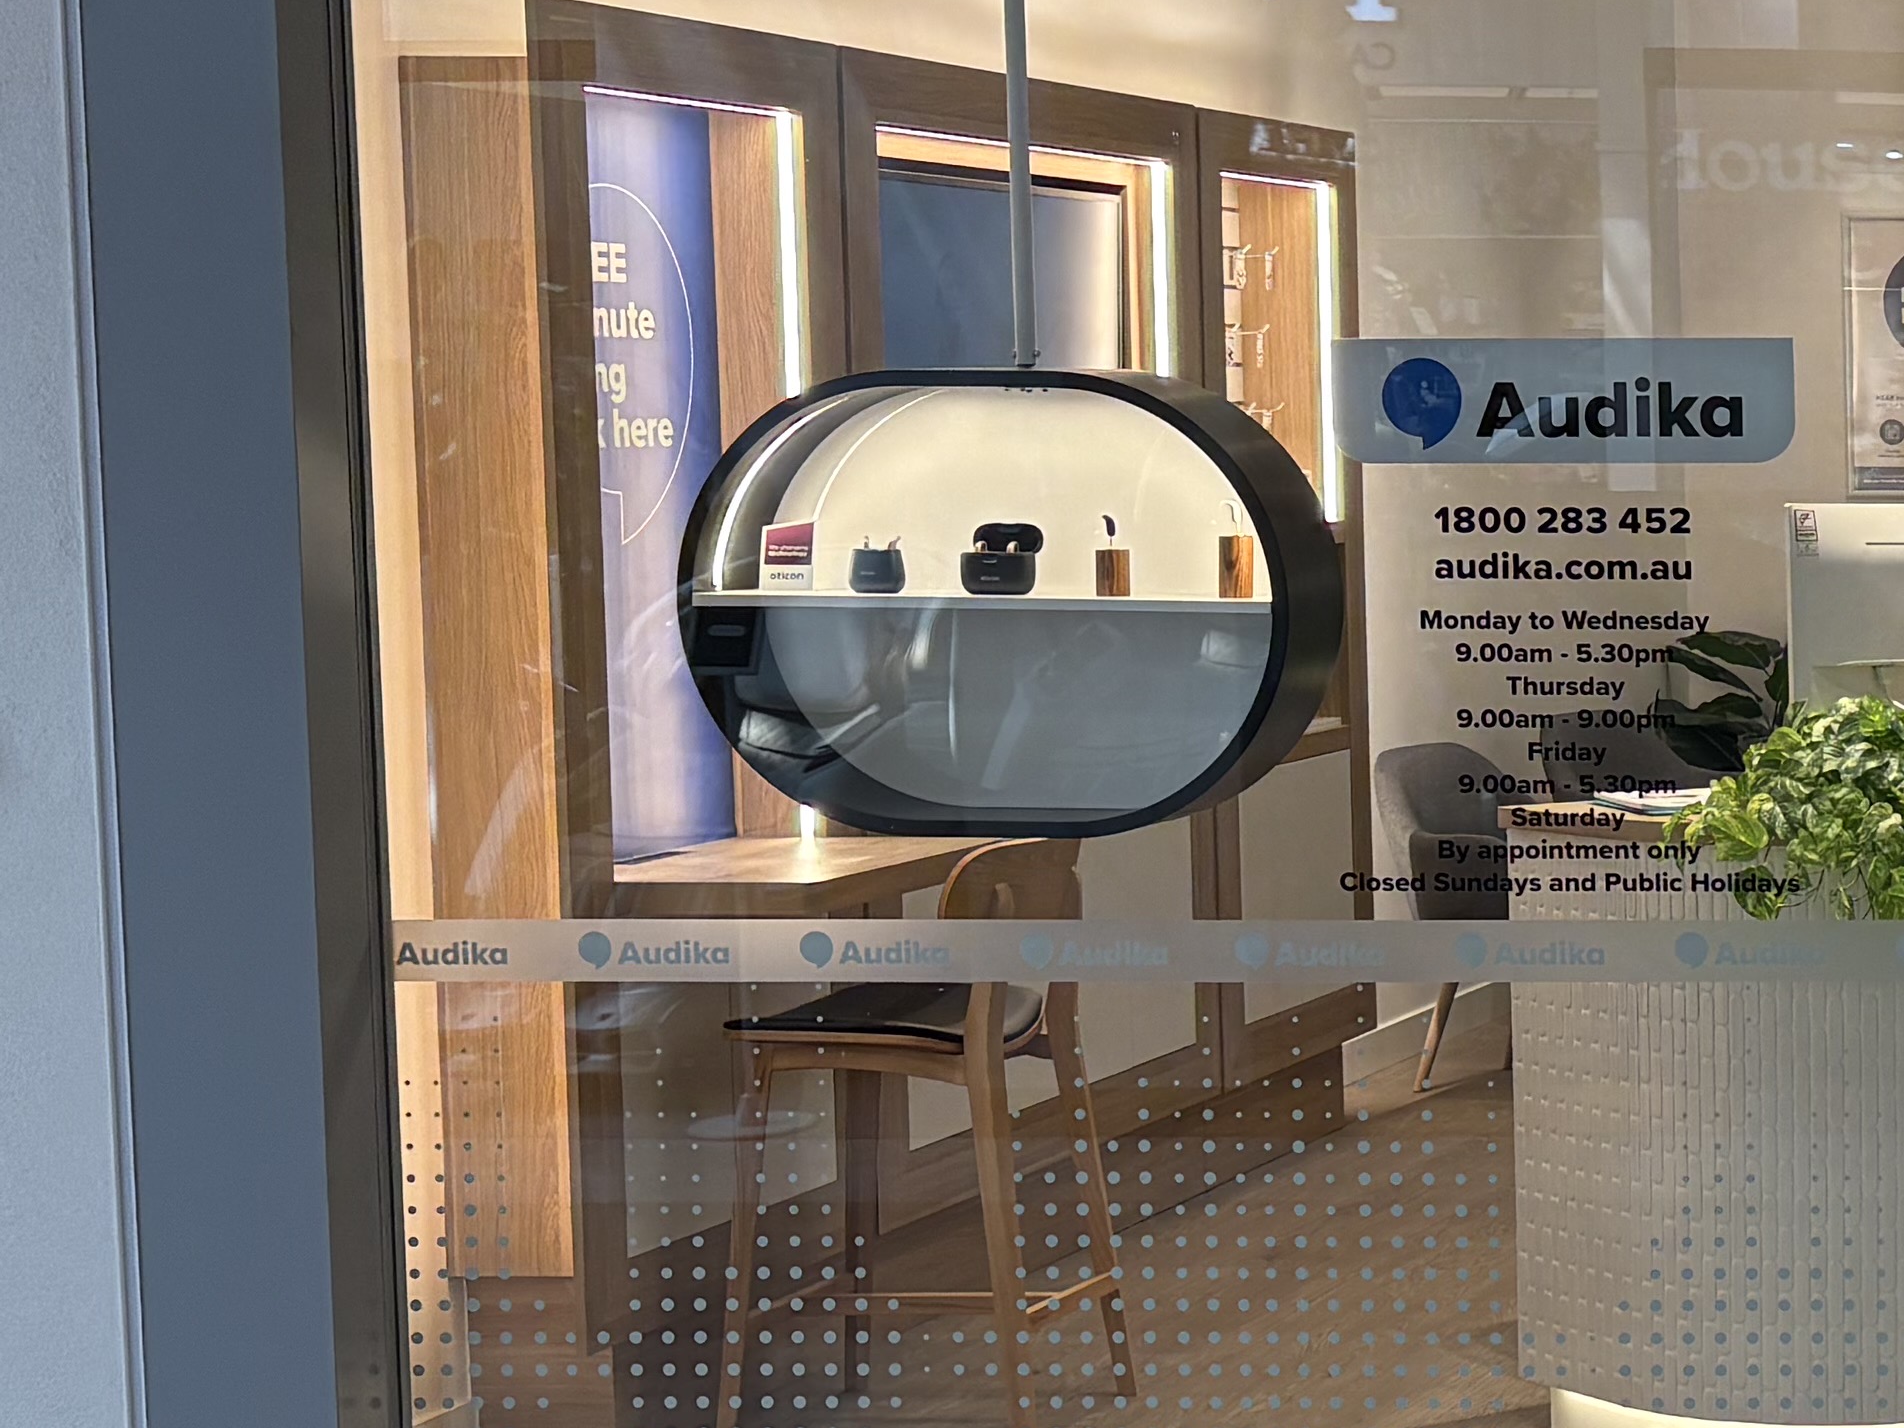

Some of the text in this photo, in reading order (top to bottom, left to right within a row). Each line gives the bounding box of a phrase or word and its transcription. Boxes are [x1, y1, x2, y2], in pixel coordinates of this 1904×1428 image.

[1476, 376, 1744, 438] Audika
[613, 409, 674, 448] here
[1434, 506, 1691, 534] 1800 283 452
[1434, 552, 1693, 581] audika.com.au
[1419, 609, 1710, 635] Monday to Wednesday
[1455, 643, 1554, 664] 9.00am
[1575, 643, 1675, 669] 5.30pm
[1506, 676, 1626, 702] Thursday
[1456, 709, 1556, 730] 9.00am
[1576, 709, 1676, 735] 9.00pm
[1526, 741, 1607, 767] Friday
[1457, 774, 1557, 796] 9.00am
[1578, 774, 1677, 800] 5.30pm
[1510, 806, 1626, 832] Saturday
[1437, 839, 1702, 866] By appointment only
[1339, 871, 1802, 898] Closed Sundays and Public Holidays
[396, 940, 508, 967] Audika
[618, 941, 730, 967] Audika
[839, 940, 951, 967] Audika
[1496, 940, 1605, 968] Audika
